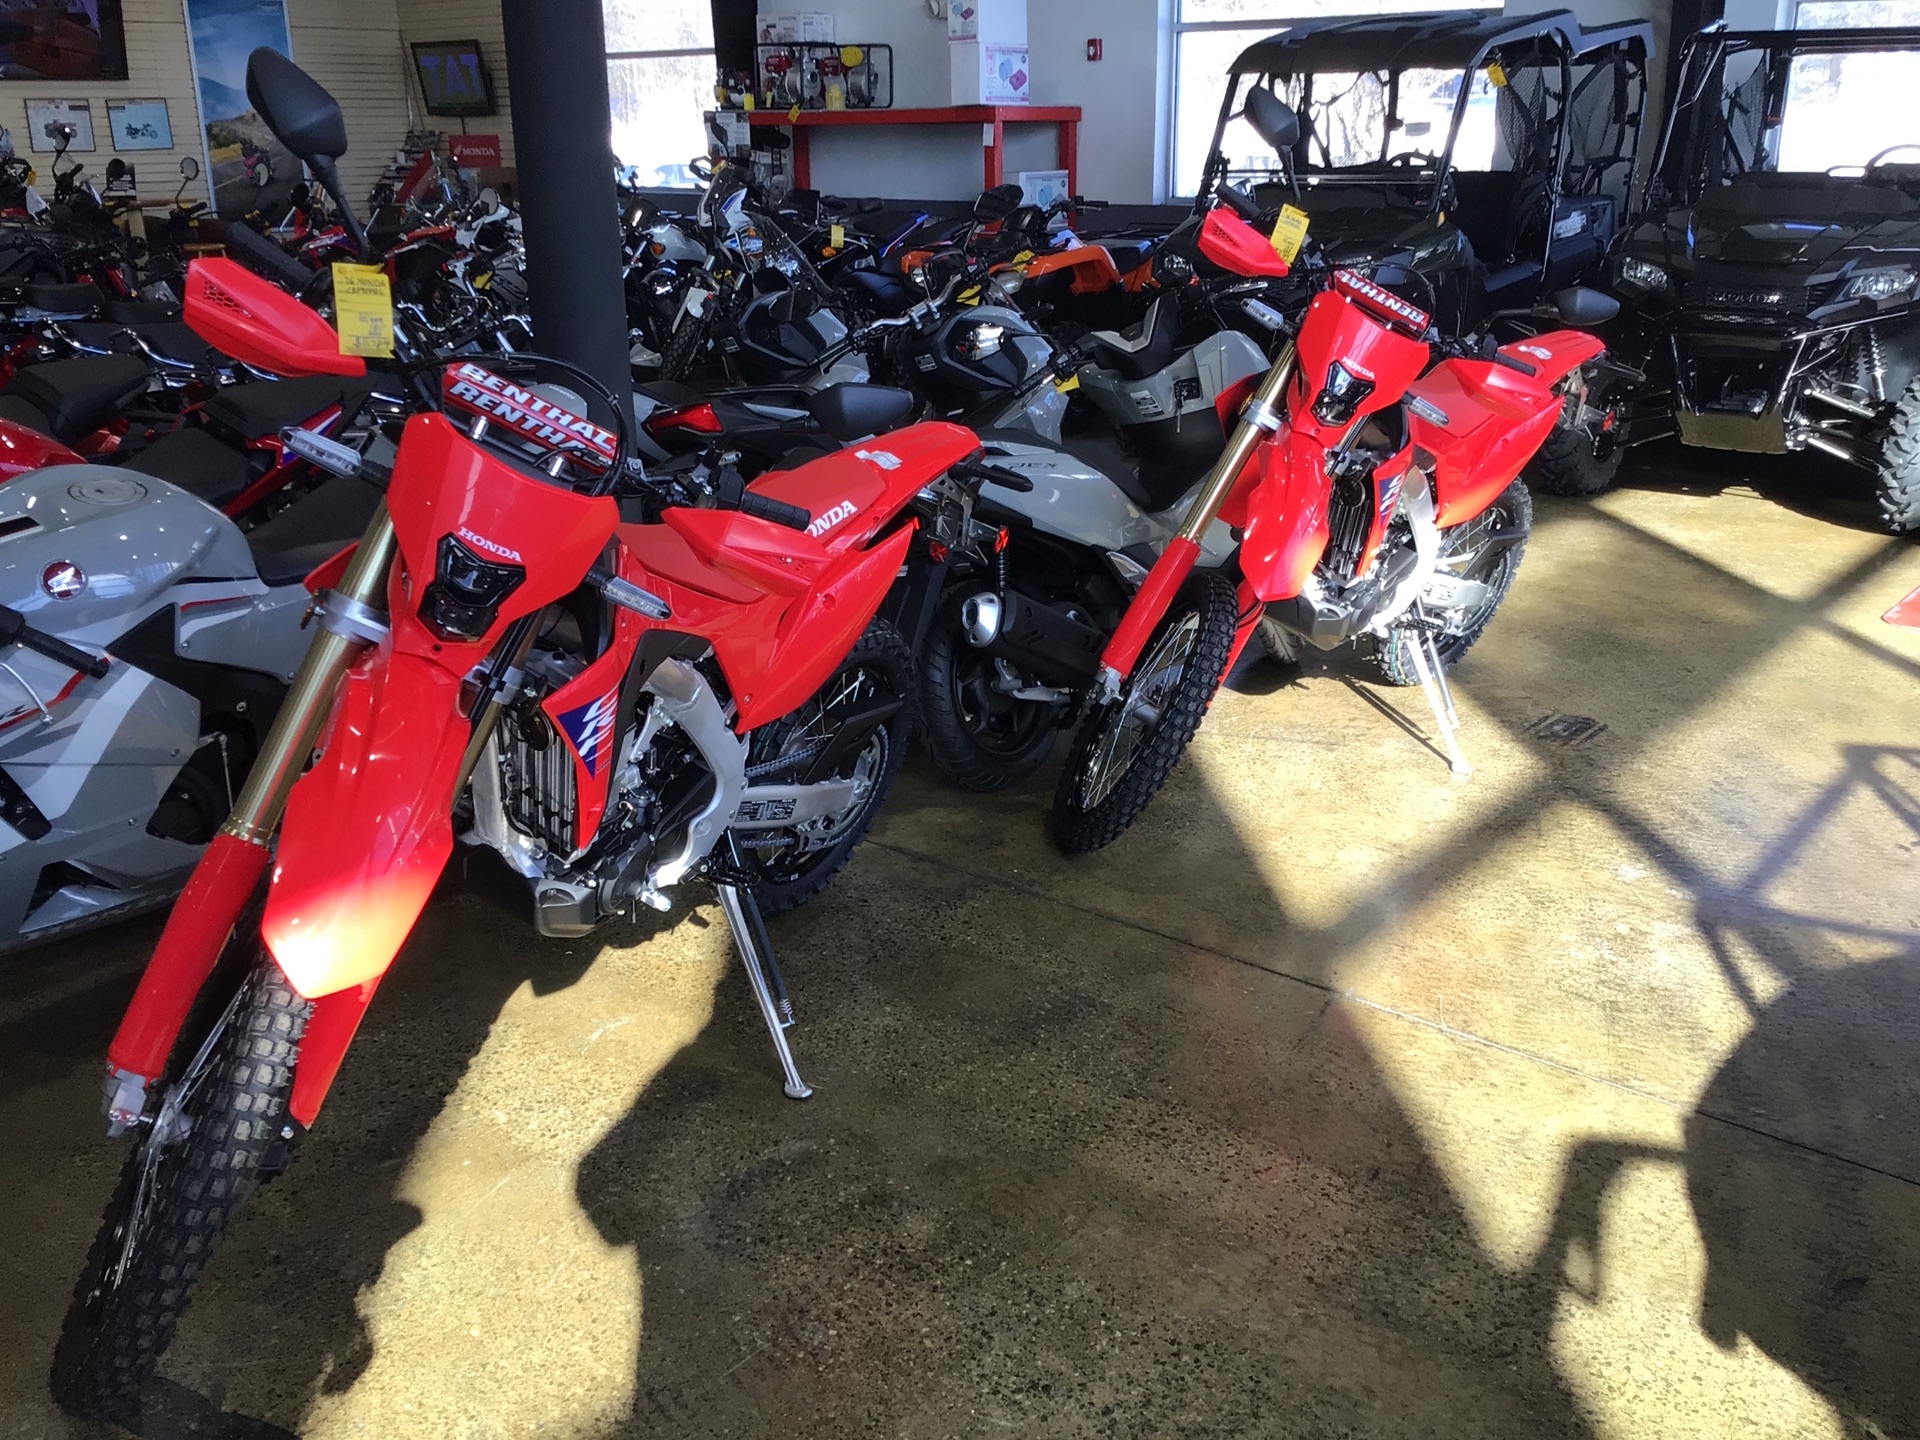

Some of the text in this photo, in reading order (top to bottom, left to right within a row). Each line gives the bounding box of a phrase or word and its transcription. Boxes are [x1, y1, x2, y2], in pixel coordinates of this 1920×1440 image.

[463, 147, 495, 156] HONDA
[1339, 270, 1425, 324] RENTHAL
[1342, 356, 1375, 379] HONDA
[459, 362, 613, 450] RENTHAL
[458, 526, 523, 563] HONDA
